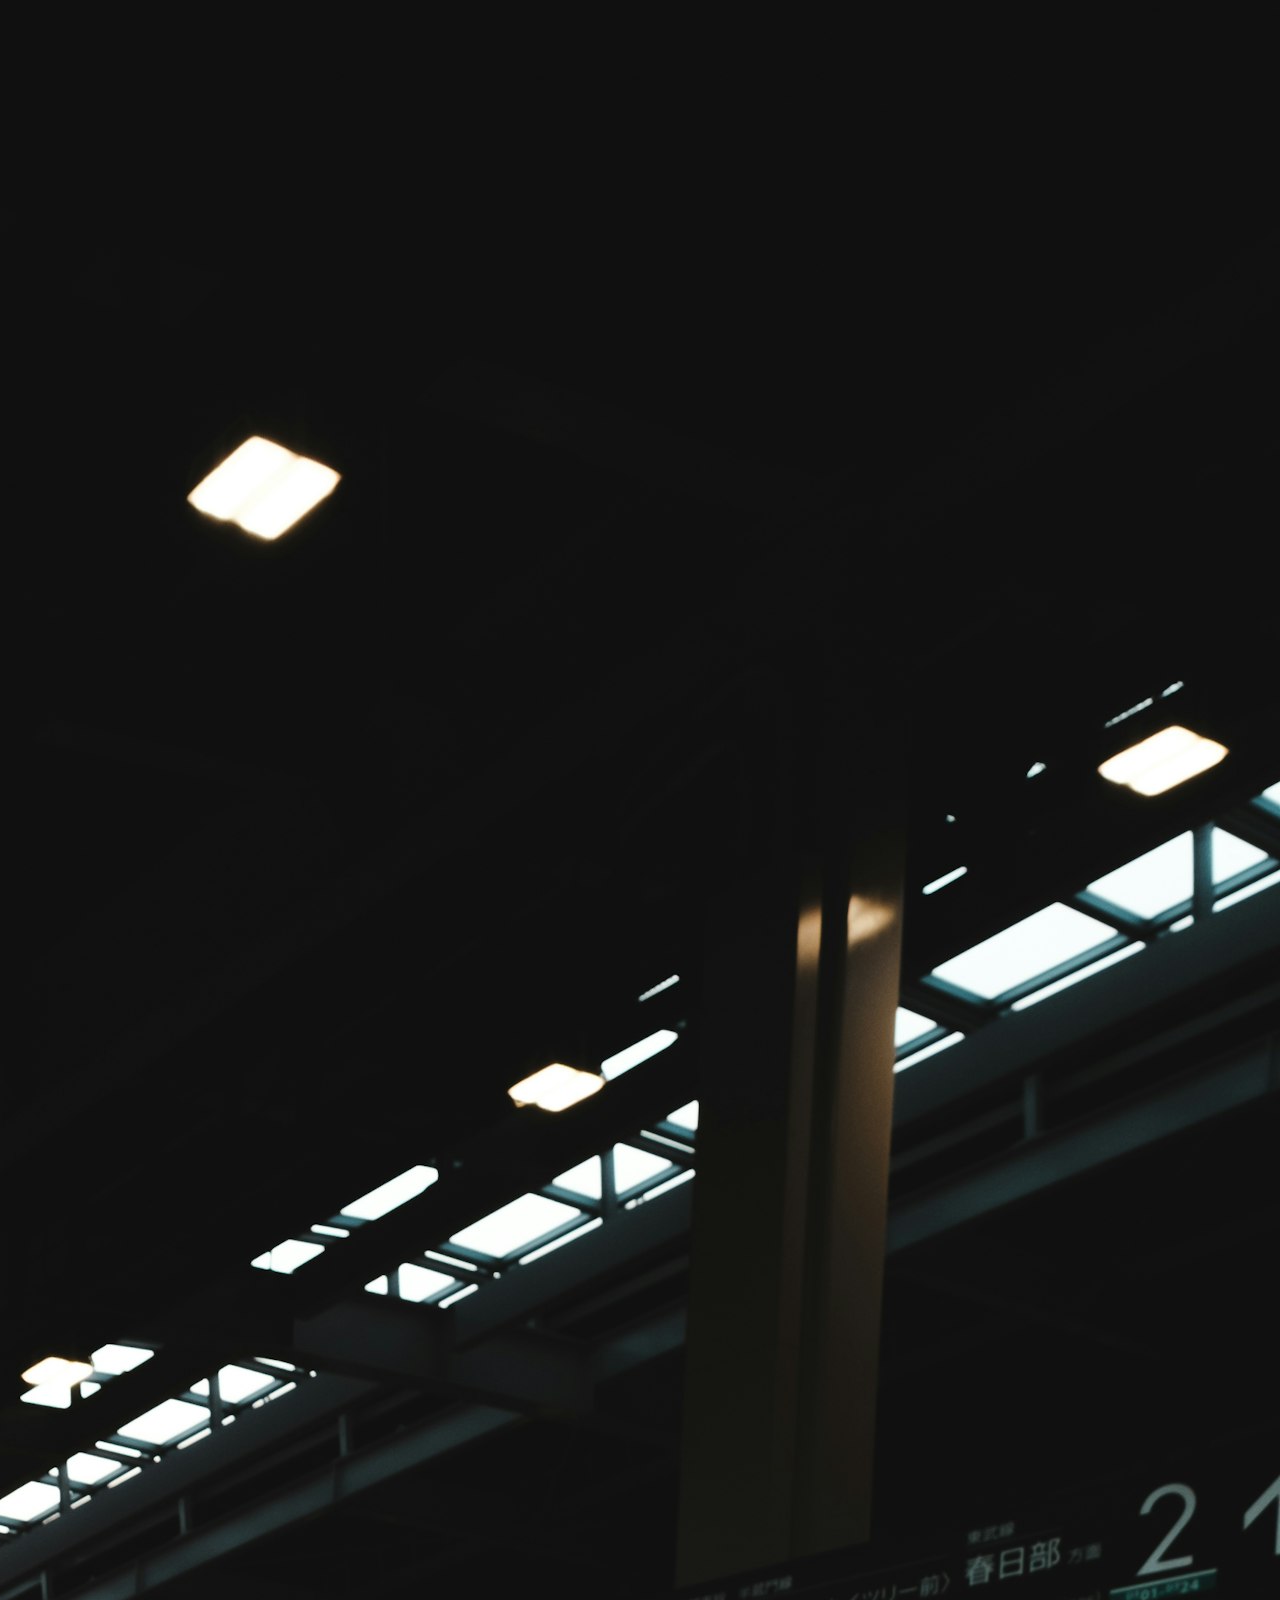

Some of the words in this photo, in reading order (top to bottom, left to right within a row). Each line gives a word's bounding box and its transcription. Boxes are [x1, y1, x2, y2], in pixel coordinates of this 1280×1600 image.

[965, 1537, 1062, 1587] 春日部
[1136, 1482, 1198, 1577] 2
